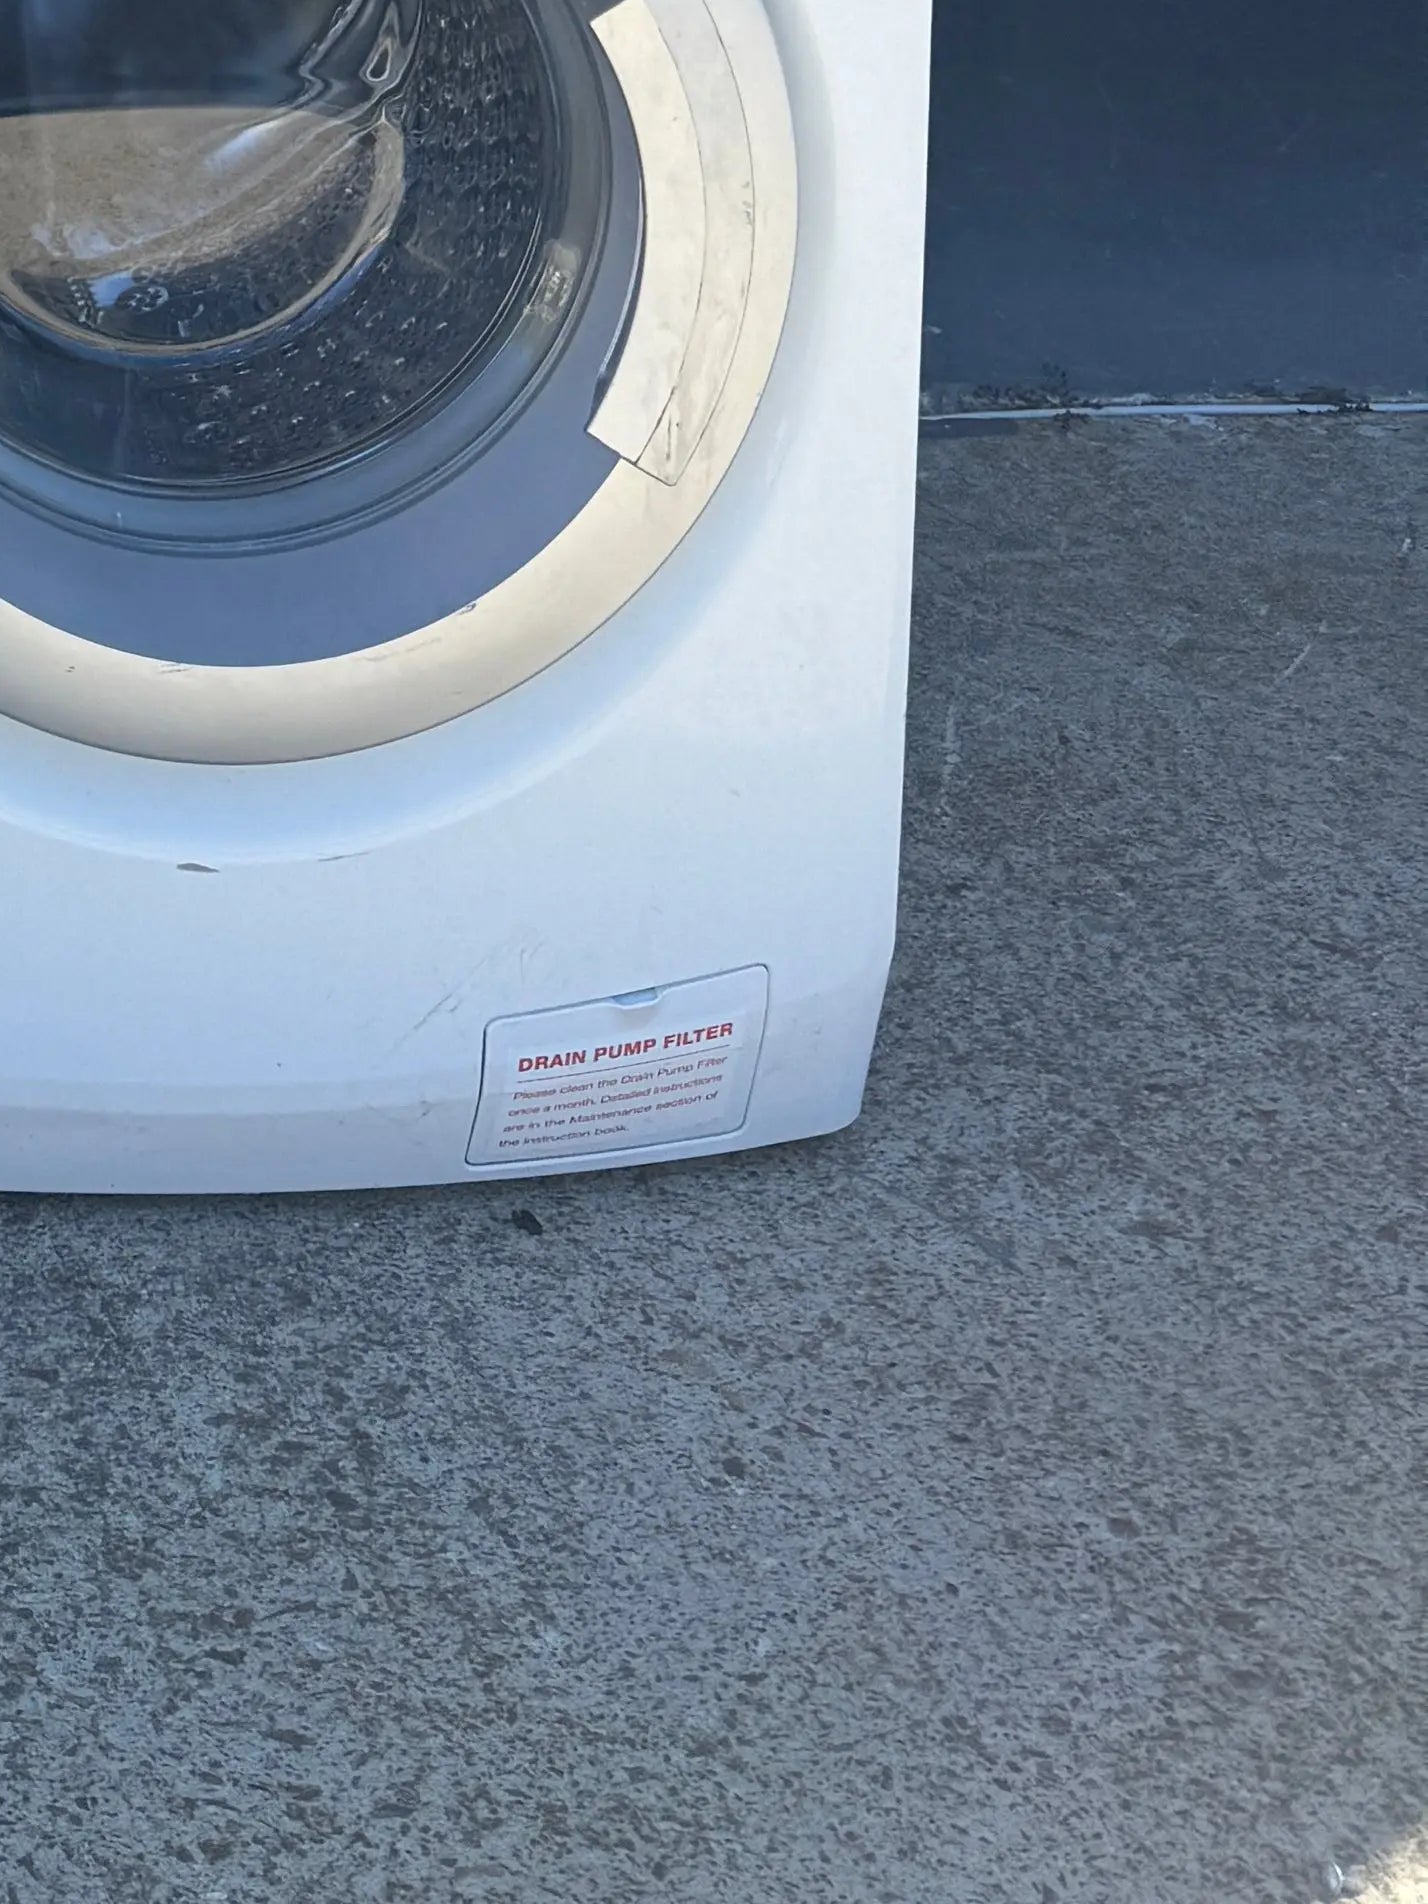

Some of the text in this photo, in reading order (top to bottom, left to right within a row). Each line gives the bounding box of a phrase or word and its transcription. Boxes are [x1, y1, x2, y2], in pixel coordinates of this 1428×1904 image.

[517, 1022, 733, 1073] DRAIN PUMP FILTER
[597, 1079, 618, 1089] the
[657, 1065, 694, 1079] Pump
[544, 1116, 566, 1127] the
[705, 1090, 719, 1101] of
[499, 1139, 520, 1148] the
